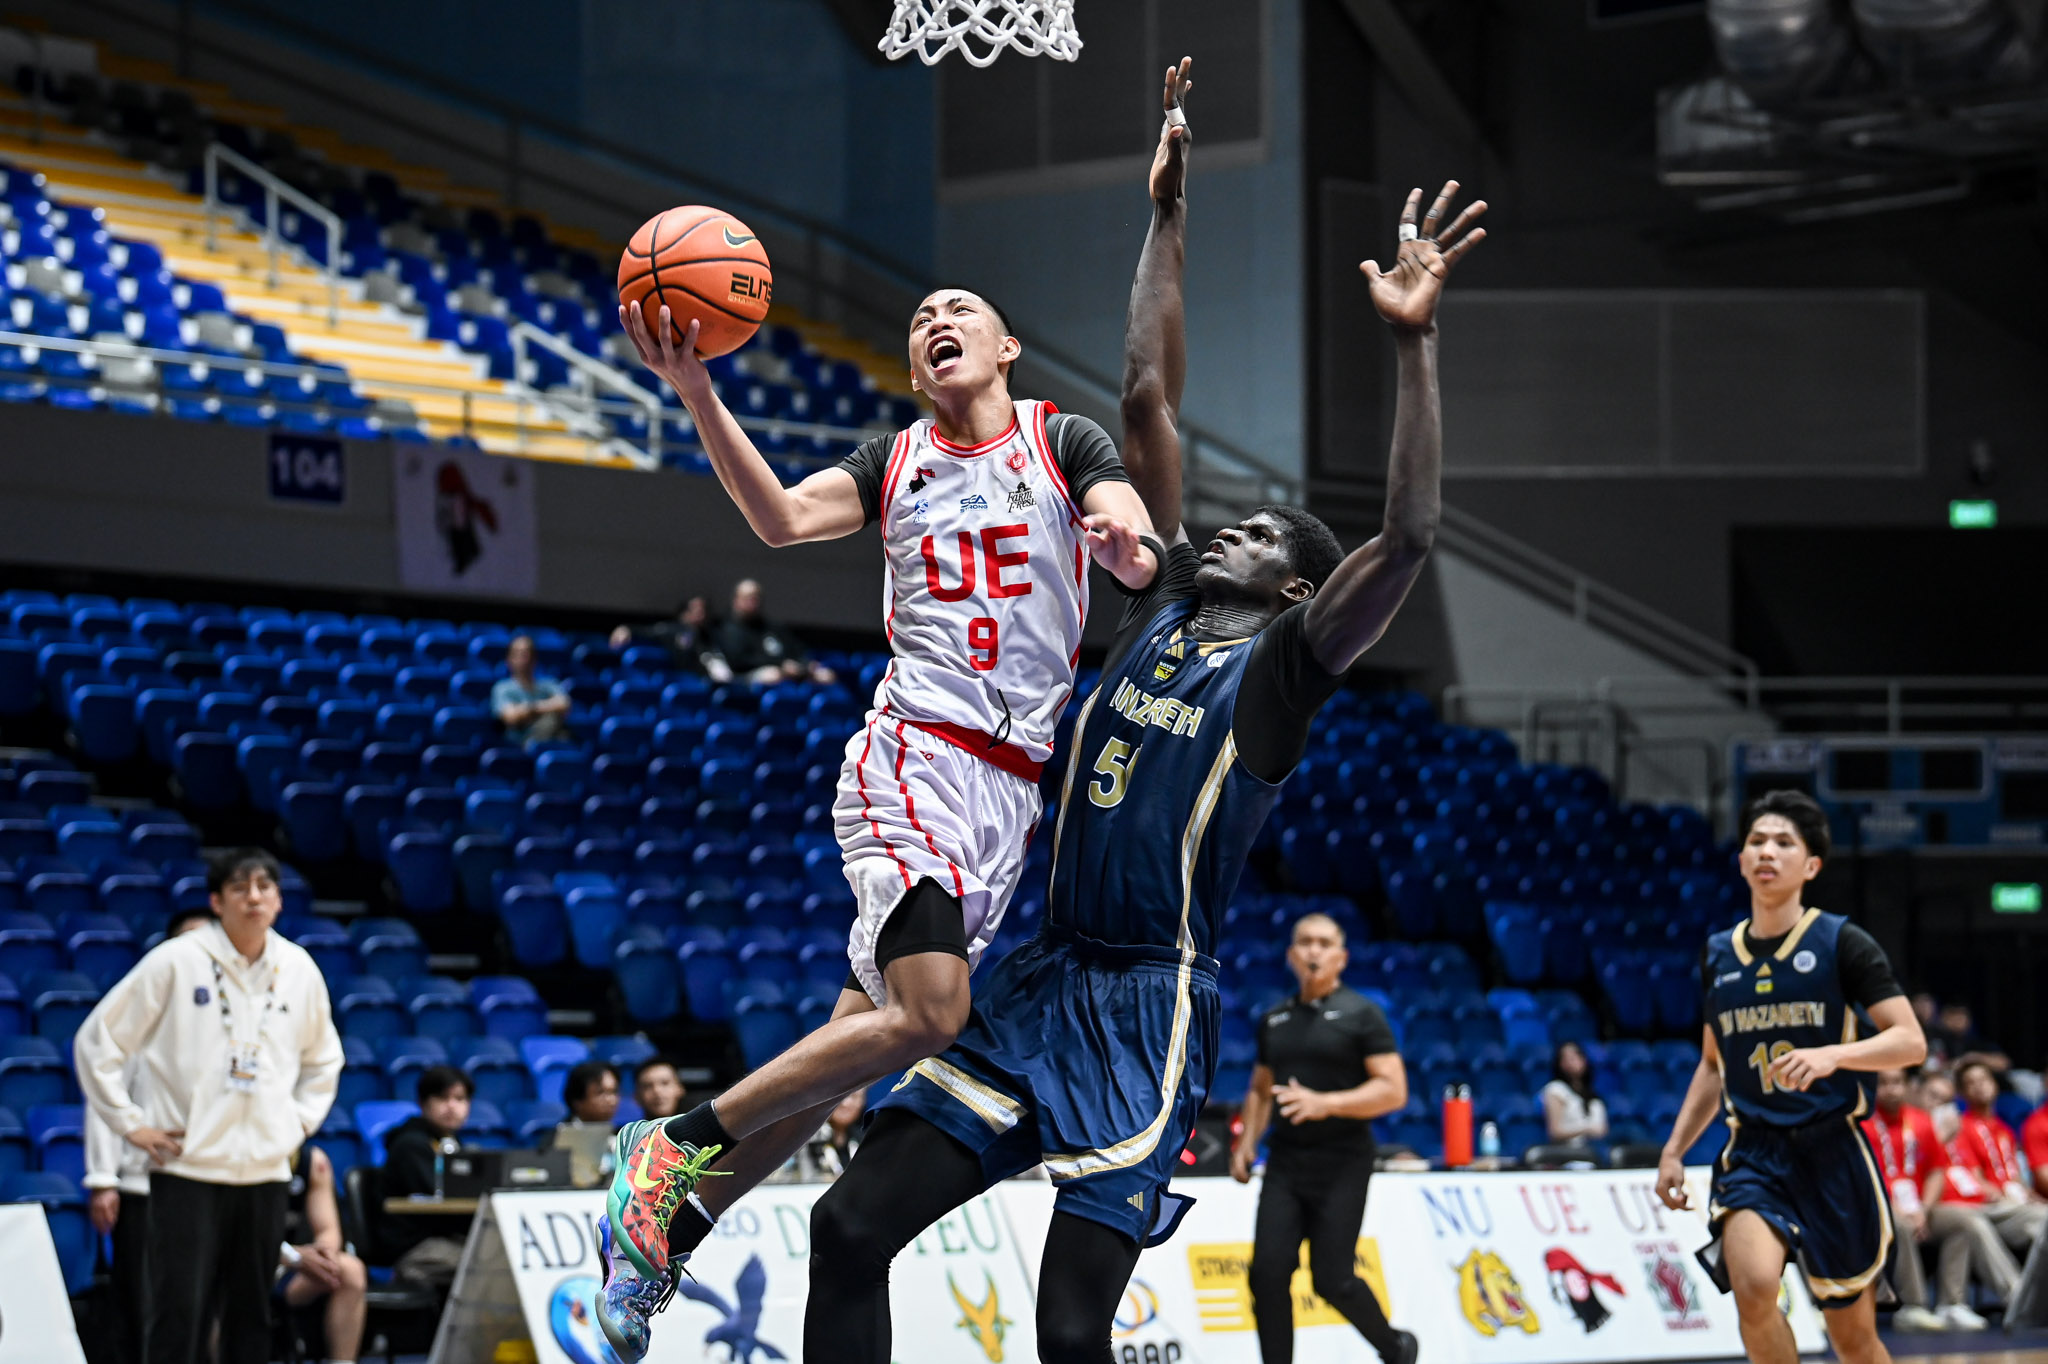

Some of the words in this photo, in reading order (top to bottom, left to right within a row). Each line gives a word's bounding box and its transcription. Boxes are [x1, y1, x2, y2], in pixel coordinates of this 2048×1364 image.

[730, 272, 772, 304] ELITE
[274, 449, 340, 491] 104
[921, 523, 1032, 602] UE
[968, 617, 998, 671] 9
[1421, 1184, 1493, 1237] NU
[1518, 1184, 1589, 1235] UE
